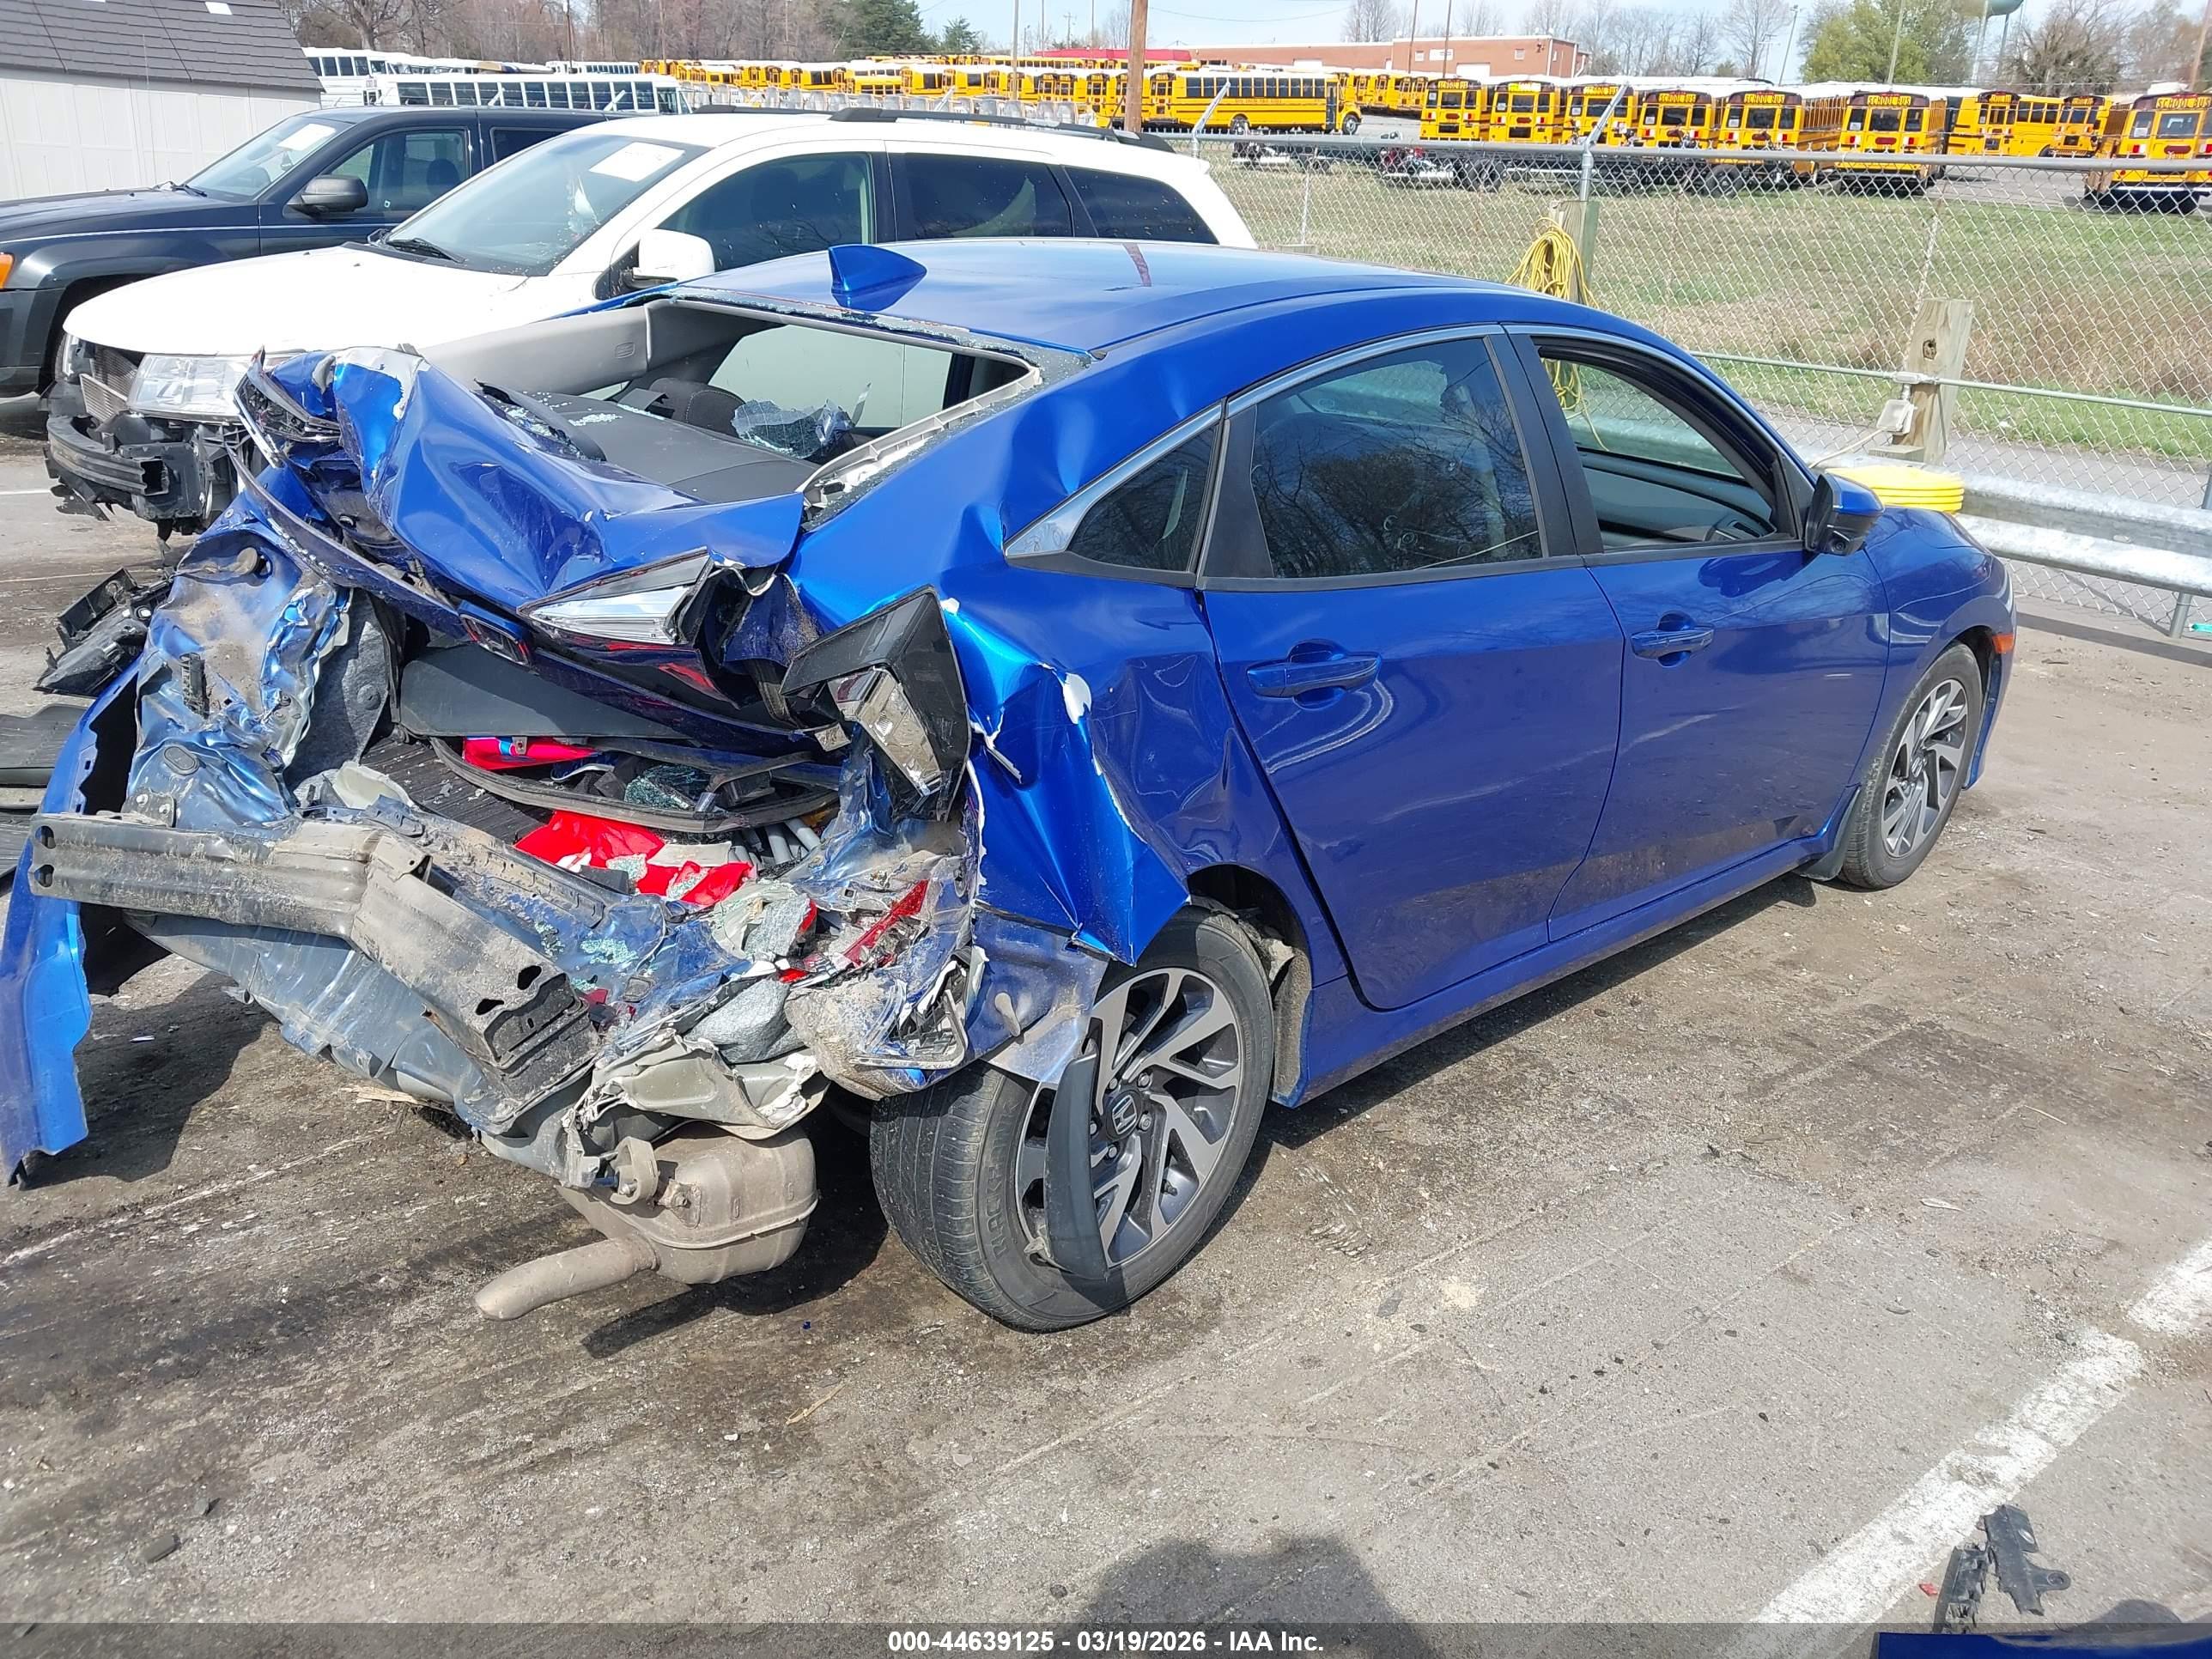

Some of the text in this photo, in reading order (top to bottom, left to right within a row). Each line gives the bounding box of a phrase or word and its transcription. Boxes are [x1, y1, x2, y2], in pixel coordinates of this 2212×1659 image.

[1868, 96, 1911, 105] SCHOOL BUS
[2158, 98, 2210, 107] SCHOOL BUS
